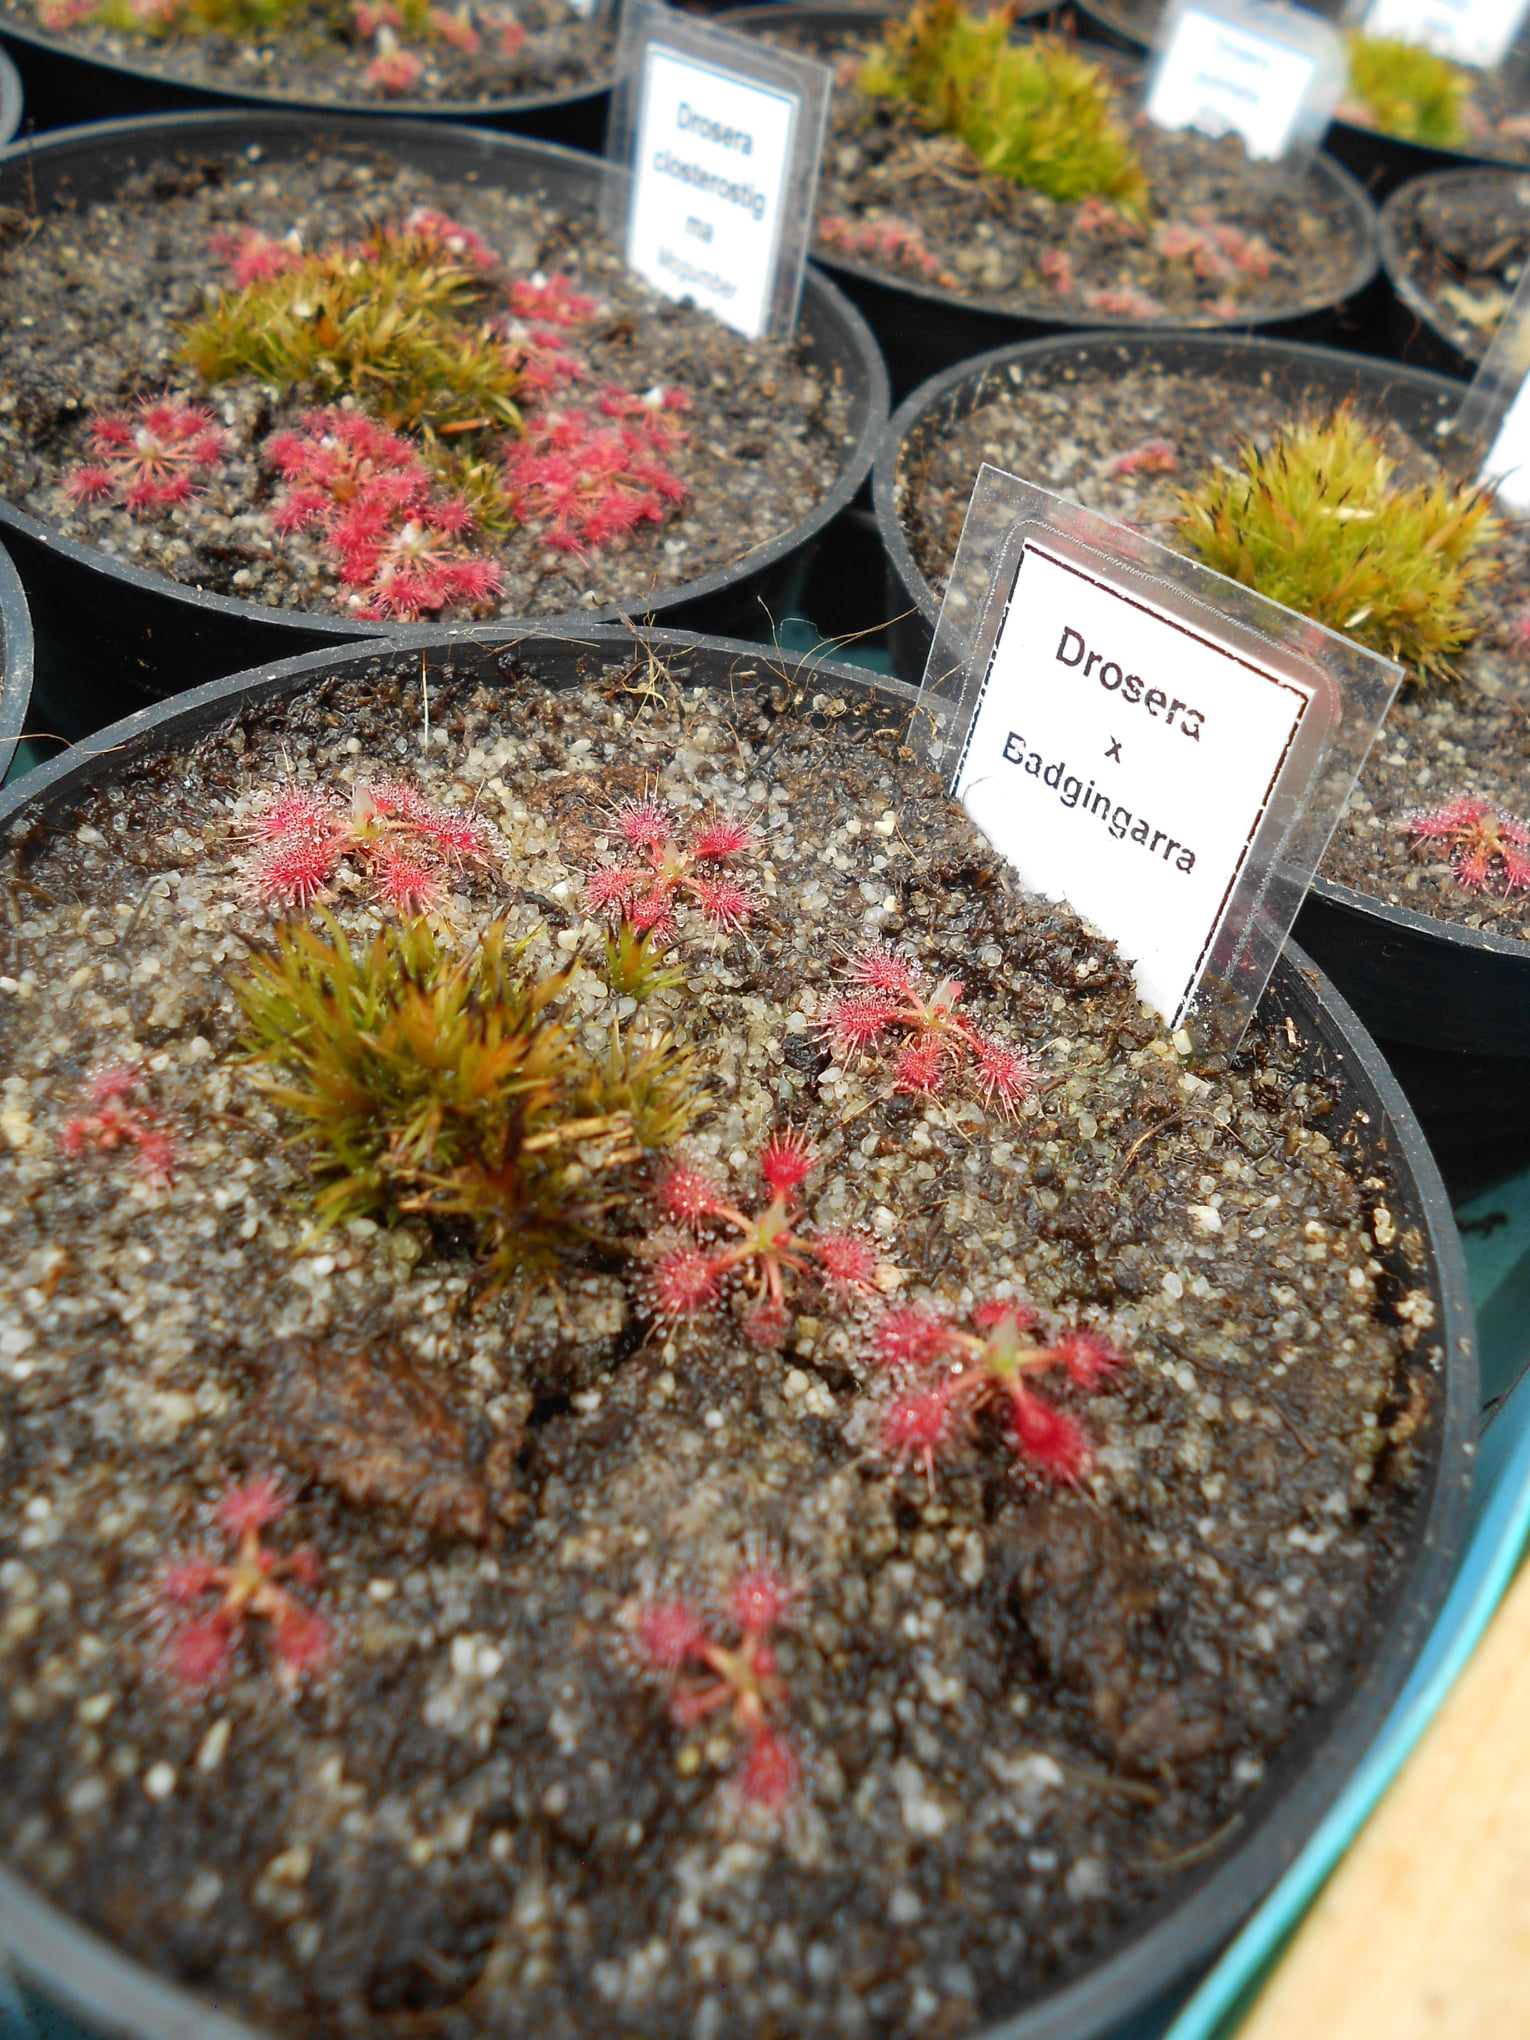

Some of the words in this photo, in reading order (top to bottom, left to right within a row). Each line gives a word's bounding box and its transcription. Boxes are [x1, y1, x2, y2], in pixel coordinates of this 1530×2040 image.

[677, 102, 752, 154] Drosera
[654, 150, 765, 220] closterostig
[687, 216, 713, 243] ma
[1055, 625, 1205, 742] Drosera
[1001, 731, 1197, 875] Badgingarra
